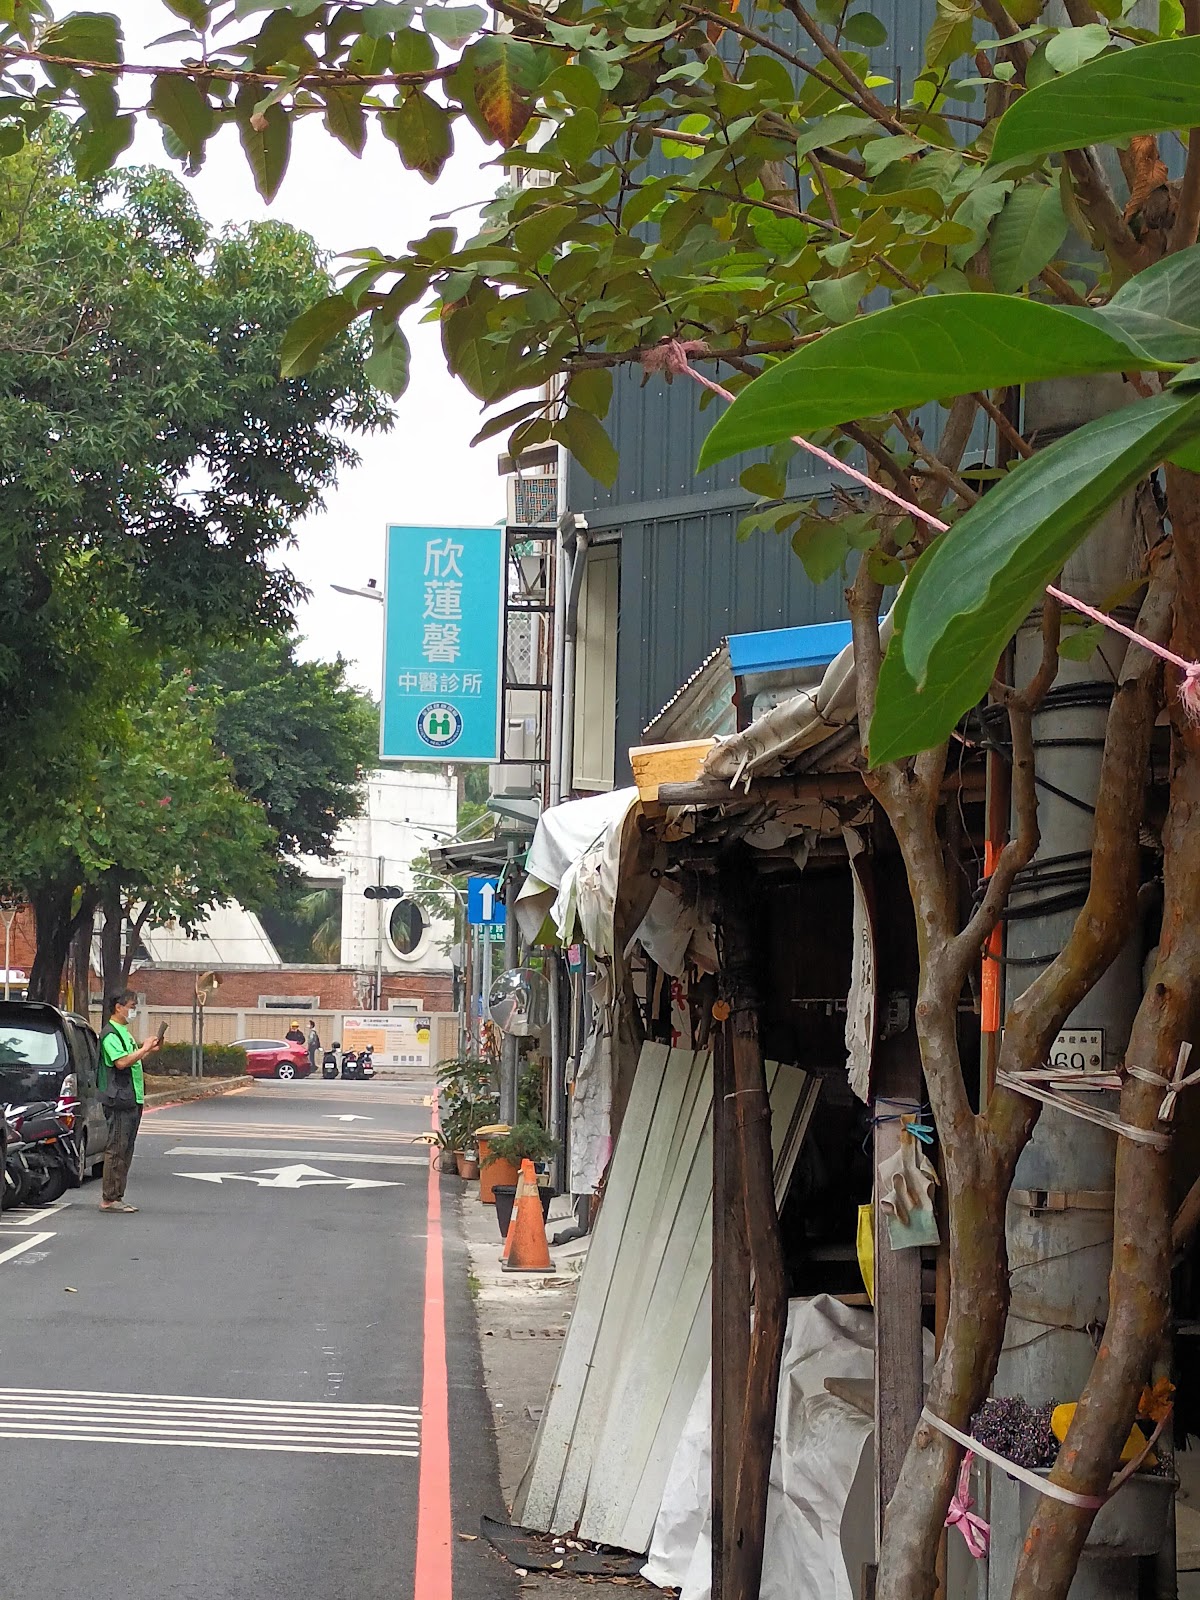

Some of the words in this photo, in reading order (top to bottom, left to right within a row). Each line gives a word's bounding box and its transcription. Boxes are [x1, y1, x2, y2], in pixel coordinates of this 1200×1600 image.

[421, 537, 464, 664] 欣蓮馨
[398, 671, 483, 695] 中醫診所
[1048, 1052, 1085, 1071] 69
